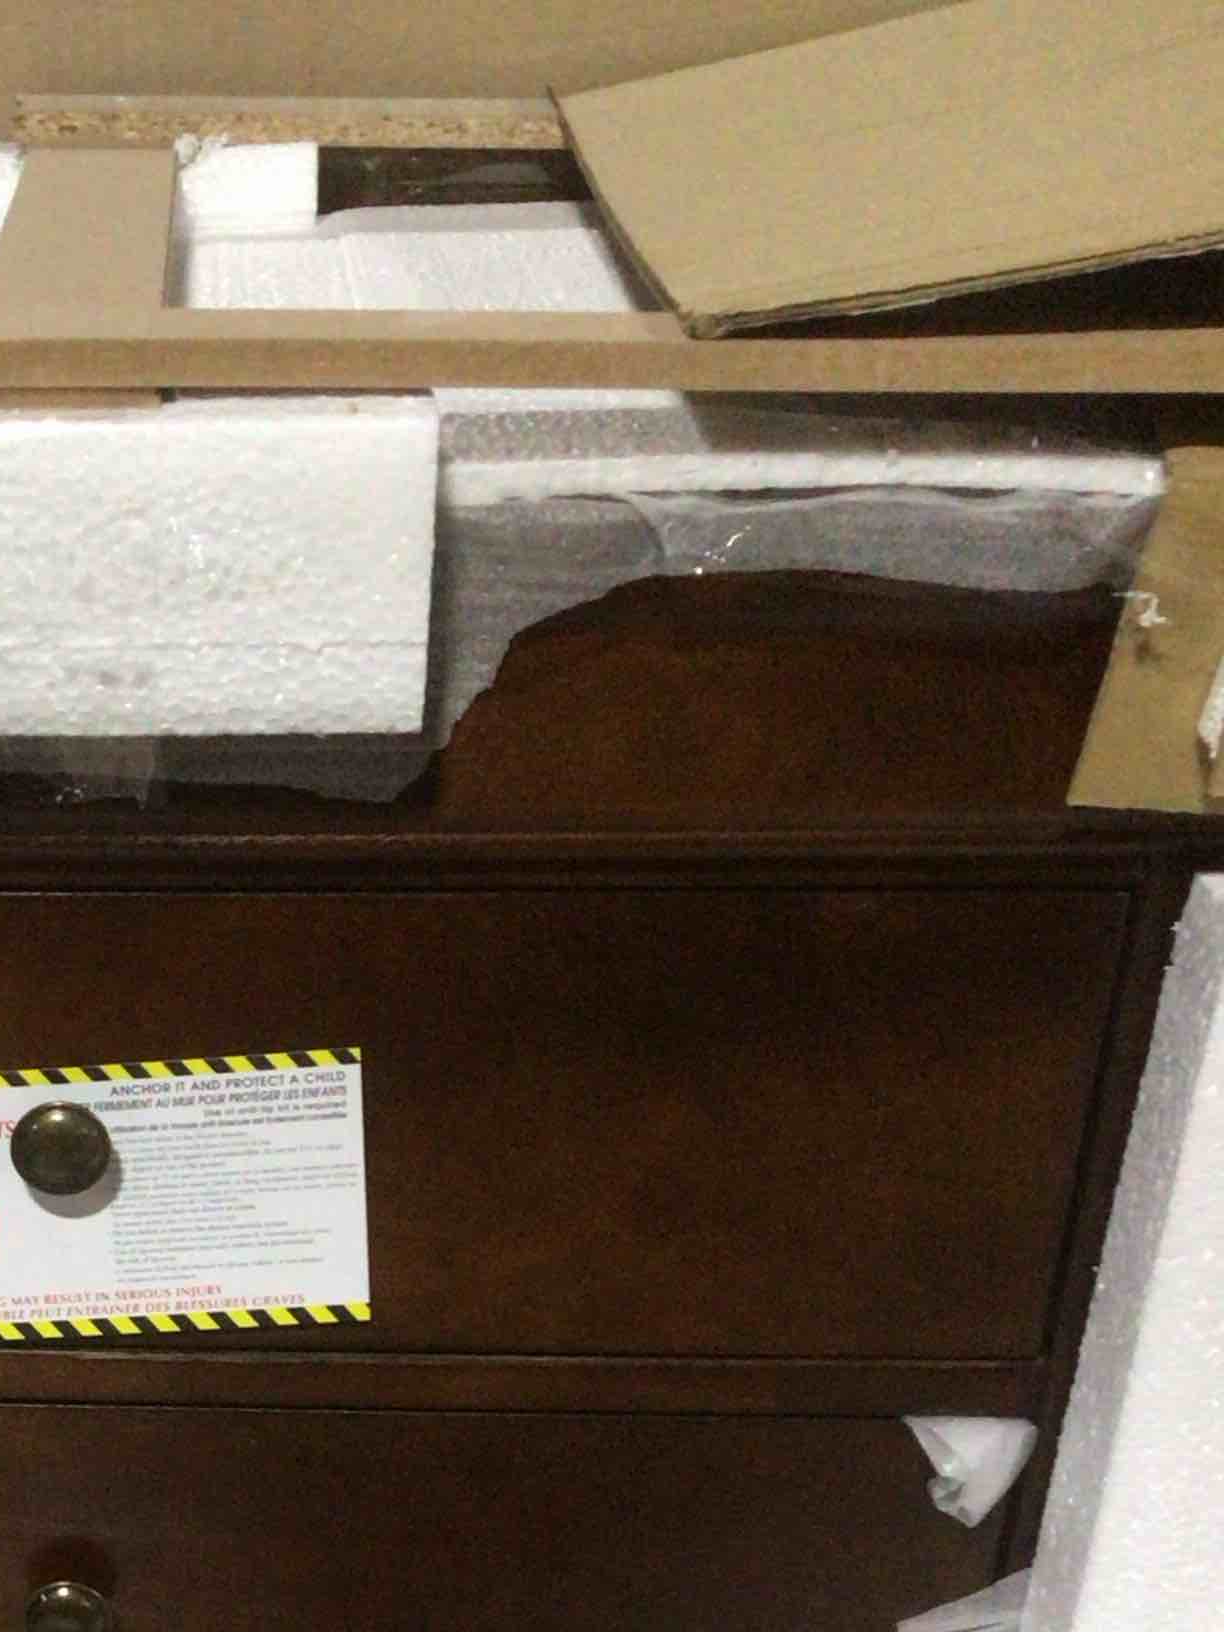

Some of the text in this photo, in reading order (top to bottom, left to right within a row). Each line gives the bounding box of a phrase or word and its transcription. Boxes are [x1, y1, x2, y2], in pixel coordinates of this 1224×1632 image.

[110, 1071, 346, 1097] ANCHOR IT AND PROTECT A CHILD
[197, 1093, 226, 1106] POUR
[301, 1085, 347, 1098] ENFANTS
[11, 1295, 39, 1306] MAY
[44, 1290, 92, 1304] RESULT
[95, 1290, 109, 1301] IN
[113, 1288, 172, 1301] SERIOUS
[176, 1285, 223, 1298] INJURY
[144, 1301, 169, 1313] DES
